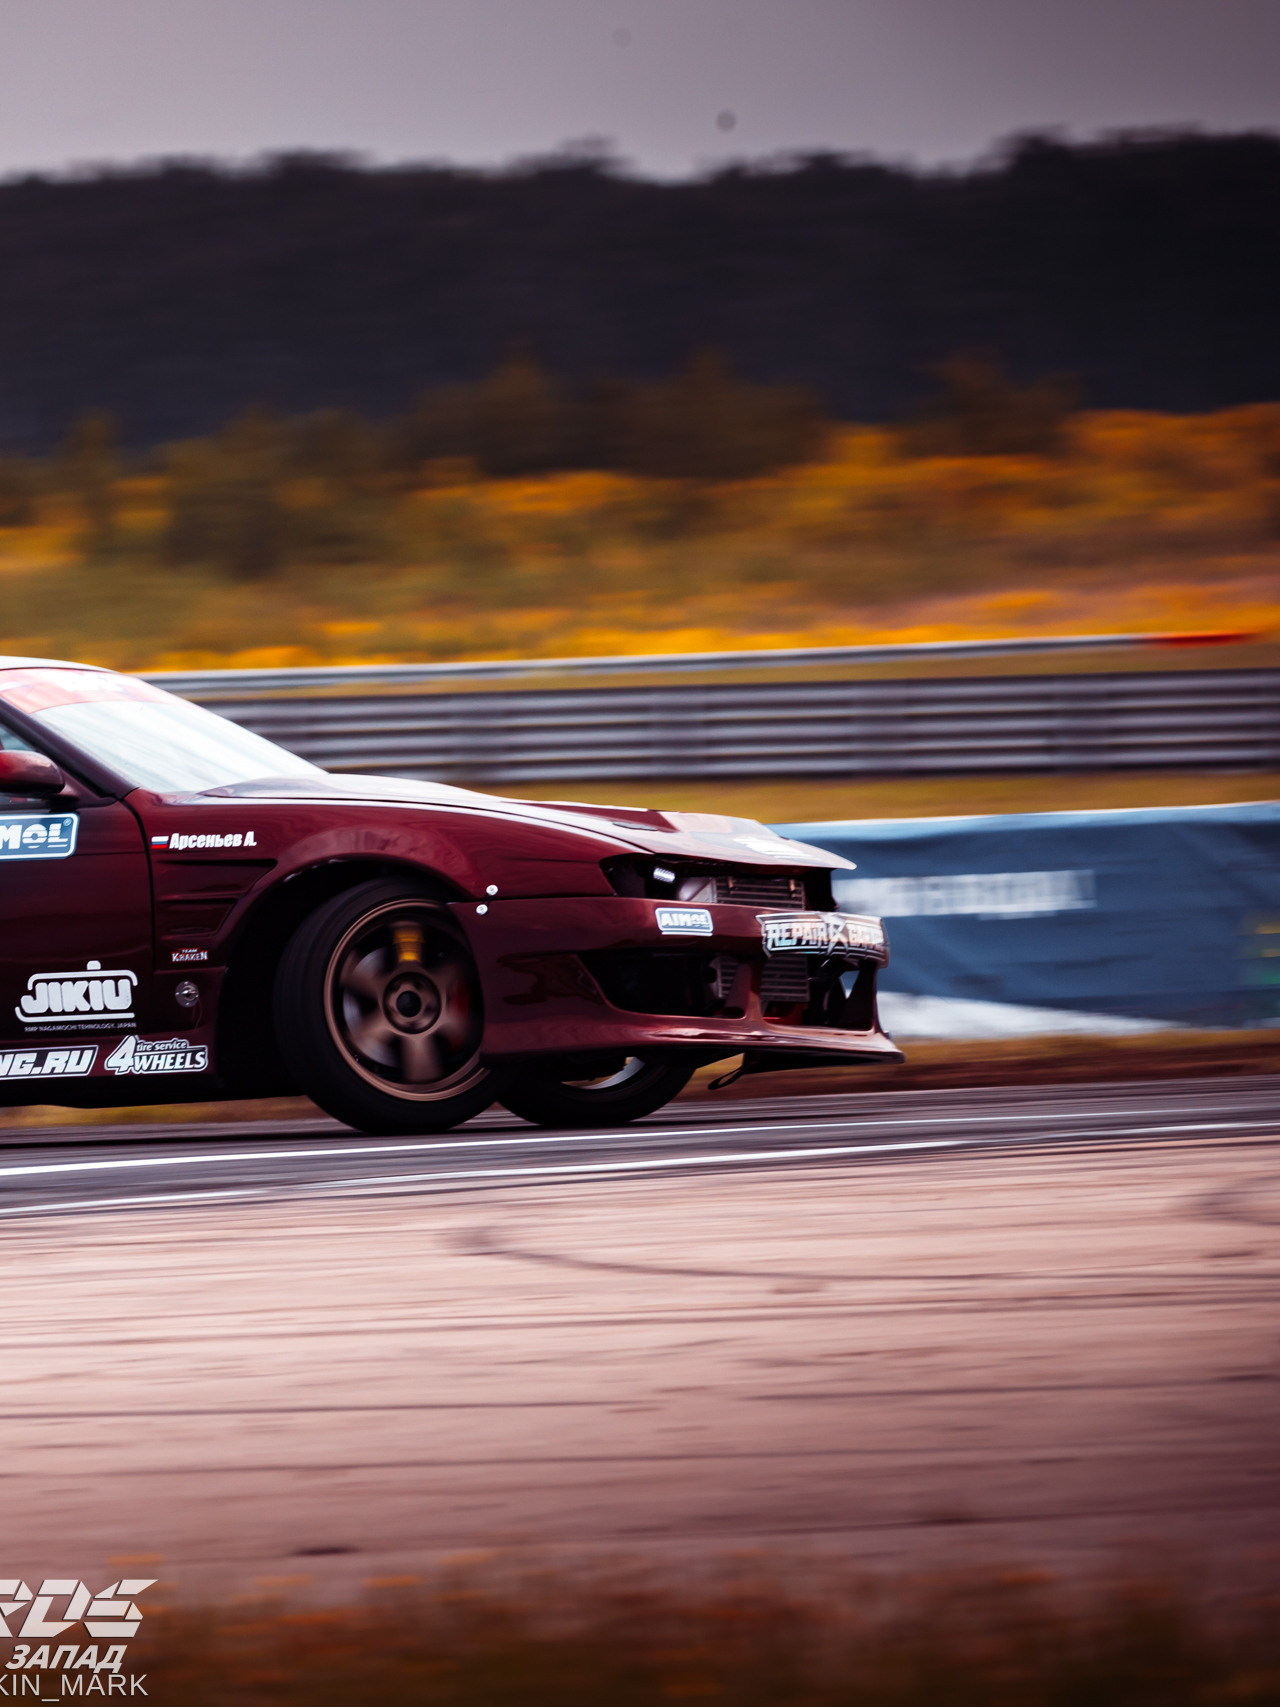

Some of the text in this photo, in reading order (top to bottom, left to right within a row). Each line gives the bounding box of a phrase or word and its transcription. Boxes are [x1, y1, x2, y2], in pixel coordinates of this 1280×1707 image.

[169, 833, 242, 850] Арсеньев
[661, 913, 710, 928] AIMOL
[172, 951, 208, 962] KRAKEN
[20, 979, 132, 1014] JIKIU
[136, 1040, 187, 1052] tire service
